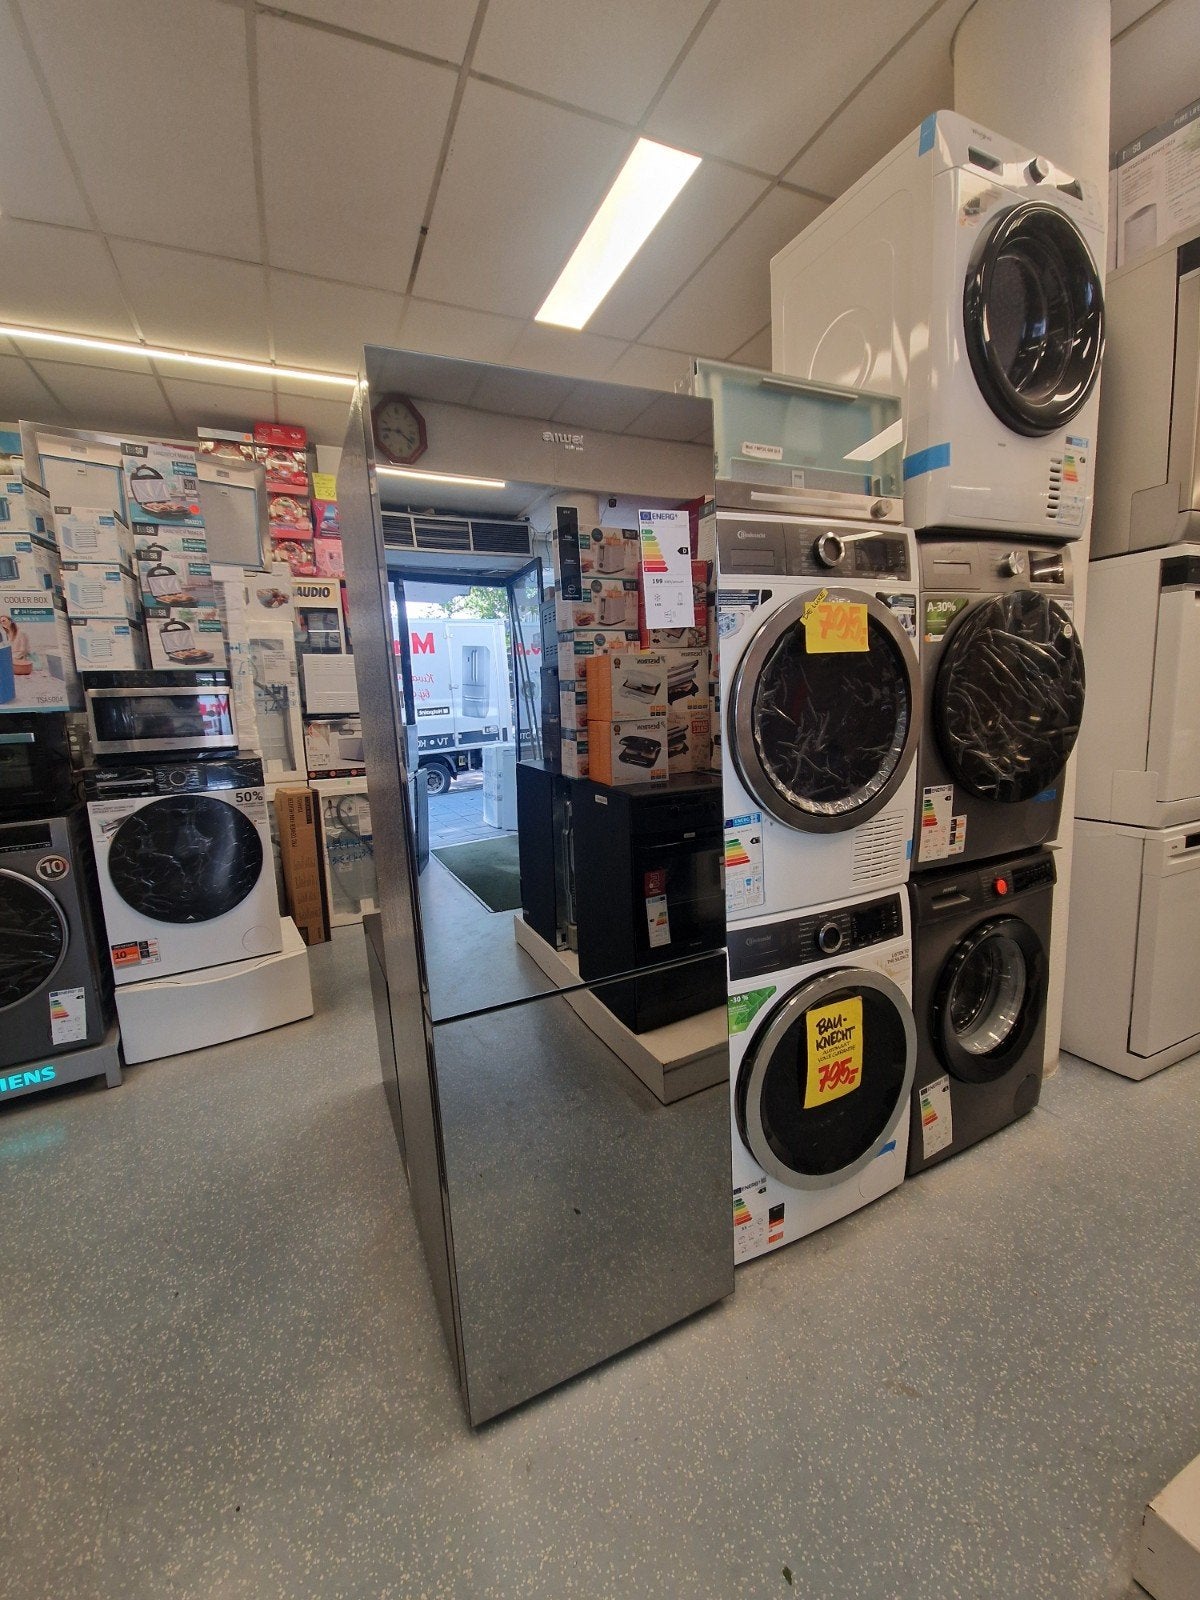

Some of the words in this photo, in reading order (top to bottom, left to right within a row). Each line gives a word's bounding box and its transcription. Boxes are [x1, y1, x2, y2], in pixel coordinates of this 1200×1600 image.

[235, 790, 264, 803] 50%
[41, 859, 65, 875] 10
[816, 1014, 847, 1035] BAU-
[815, 1026, 856, 1052] KNECHT
